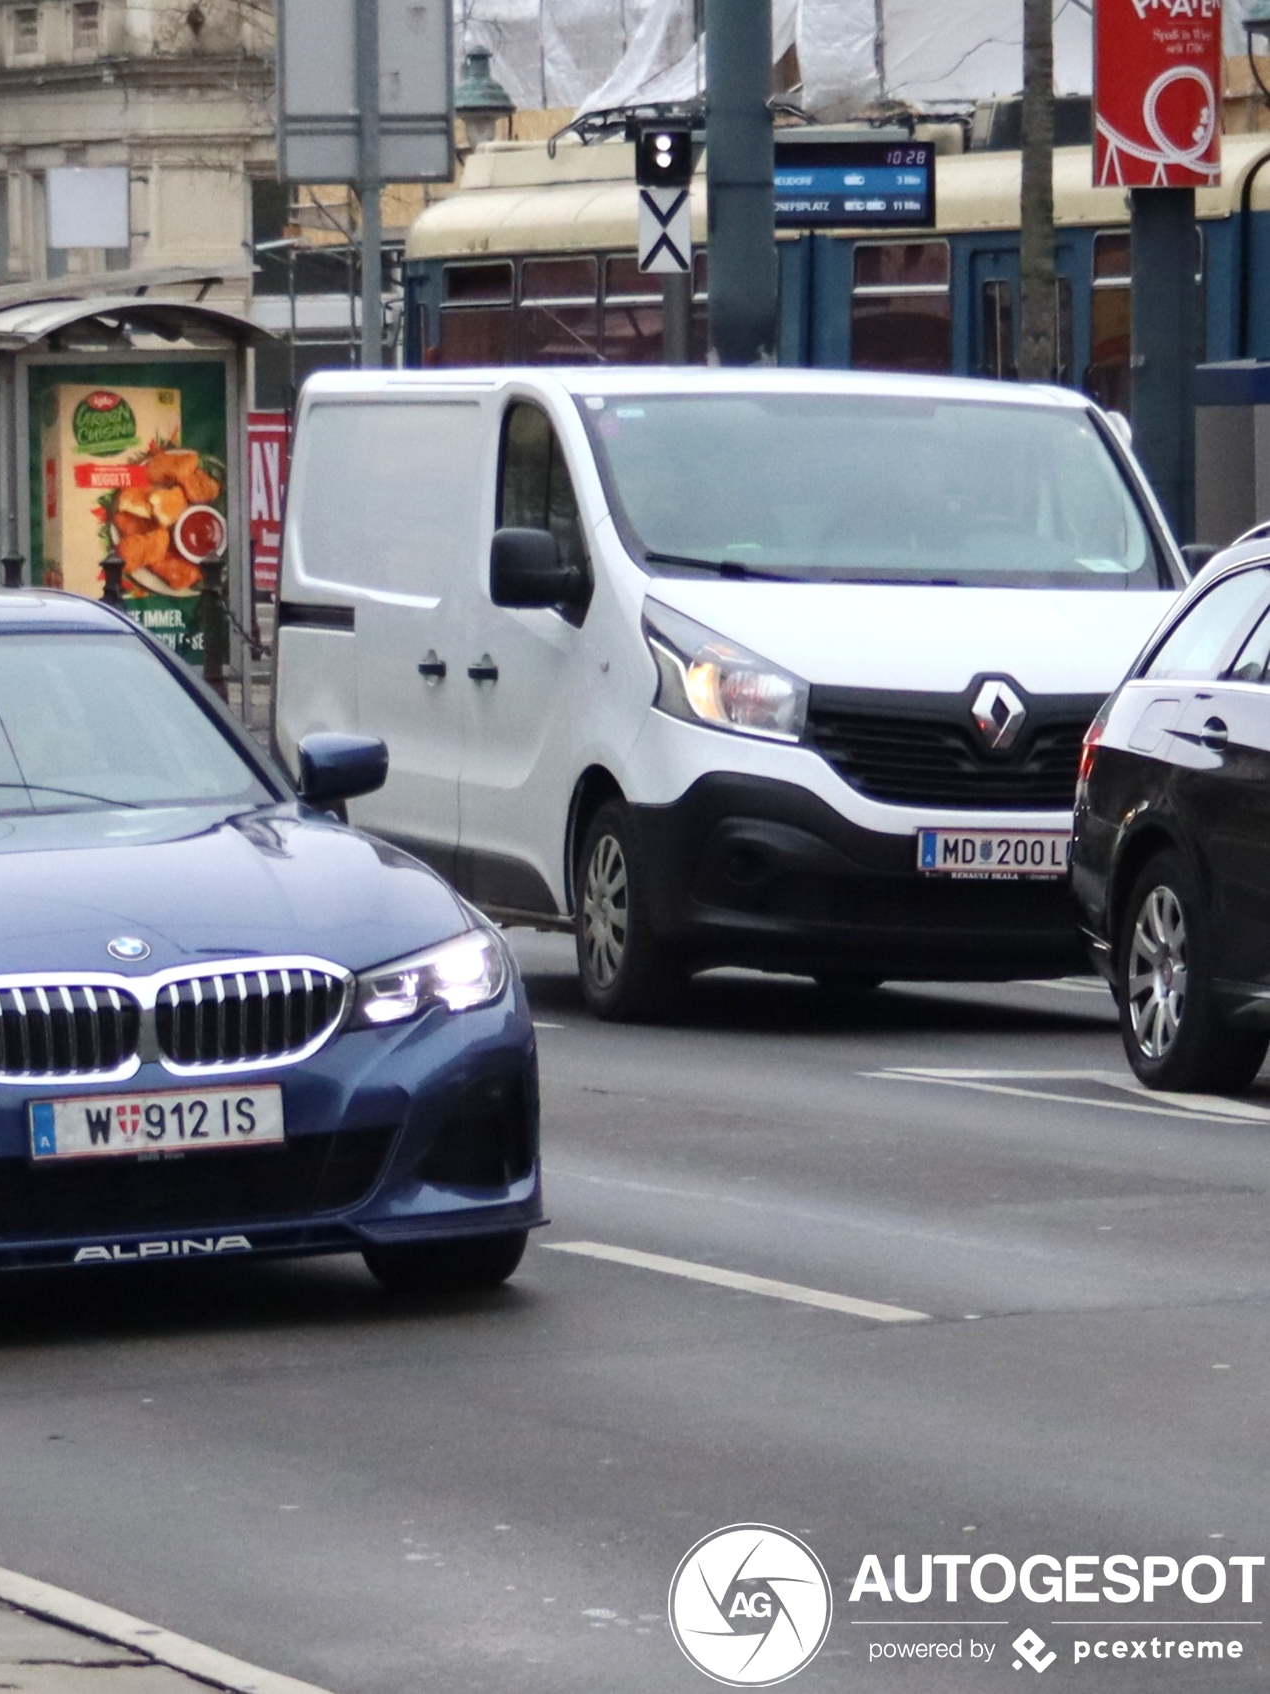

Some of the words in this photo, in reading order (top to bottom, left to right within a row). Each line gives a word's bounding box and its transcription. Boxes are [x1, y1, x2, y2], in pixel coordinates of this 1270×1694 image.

[91, 472, 131, 487] NUGGETS
[143, 609, 186, 629] IMMER,
[943, 838, 976, 864] MD
[996, 839, 1045, 865] 200
[1051, 840, 1071, 866] L
[951, 872, 989, 880] RENAULT
[40, 1136, 51, 1148] A
[85, 1107, 112, 1146] W
[145, 1101, 210, 1141] 912
[221, 1097, 256, 1136] IS
[73, 1235, 252, 1263] ALPINA
